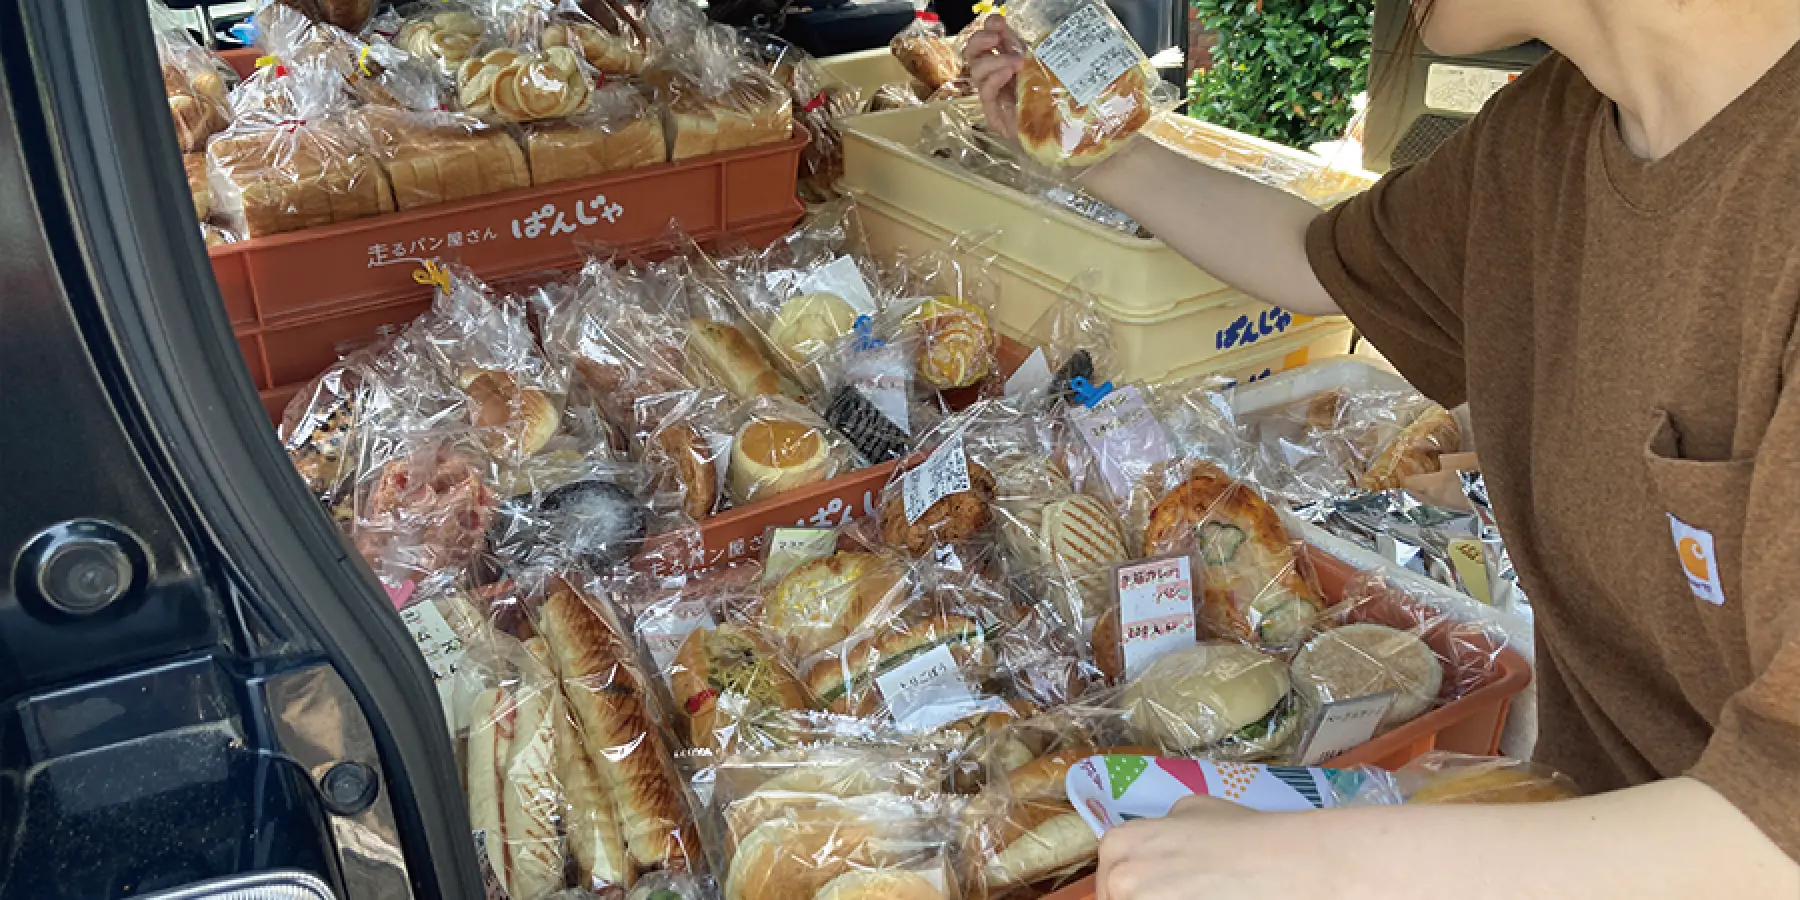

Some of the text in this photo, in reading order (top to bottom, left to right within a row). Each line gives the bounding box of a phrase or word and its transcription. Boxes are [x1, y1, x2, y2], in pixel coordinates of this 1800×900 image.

[368, 194, 624, 268] 走るパン屋さん ぱんじゃ
[1215, 305, 1291, 351] ぱんじゃ
